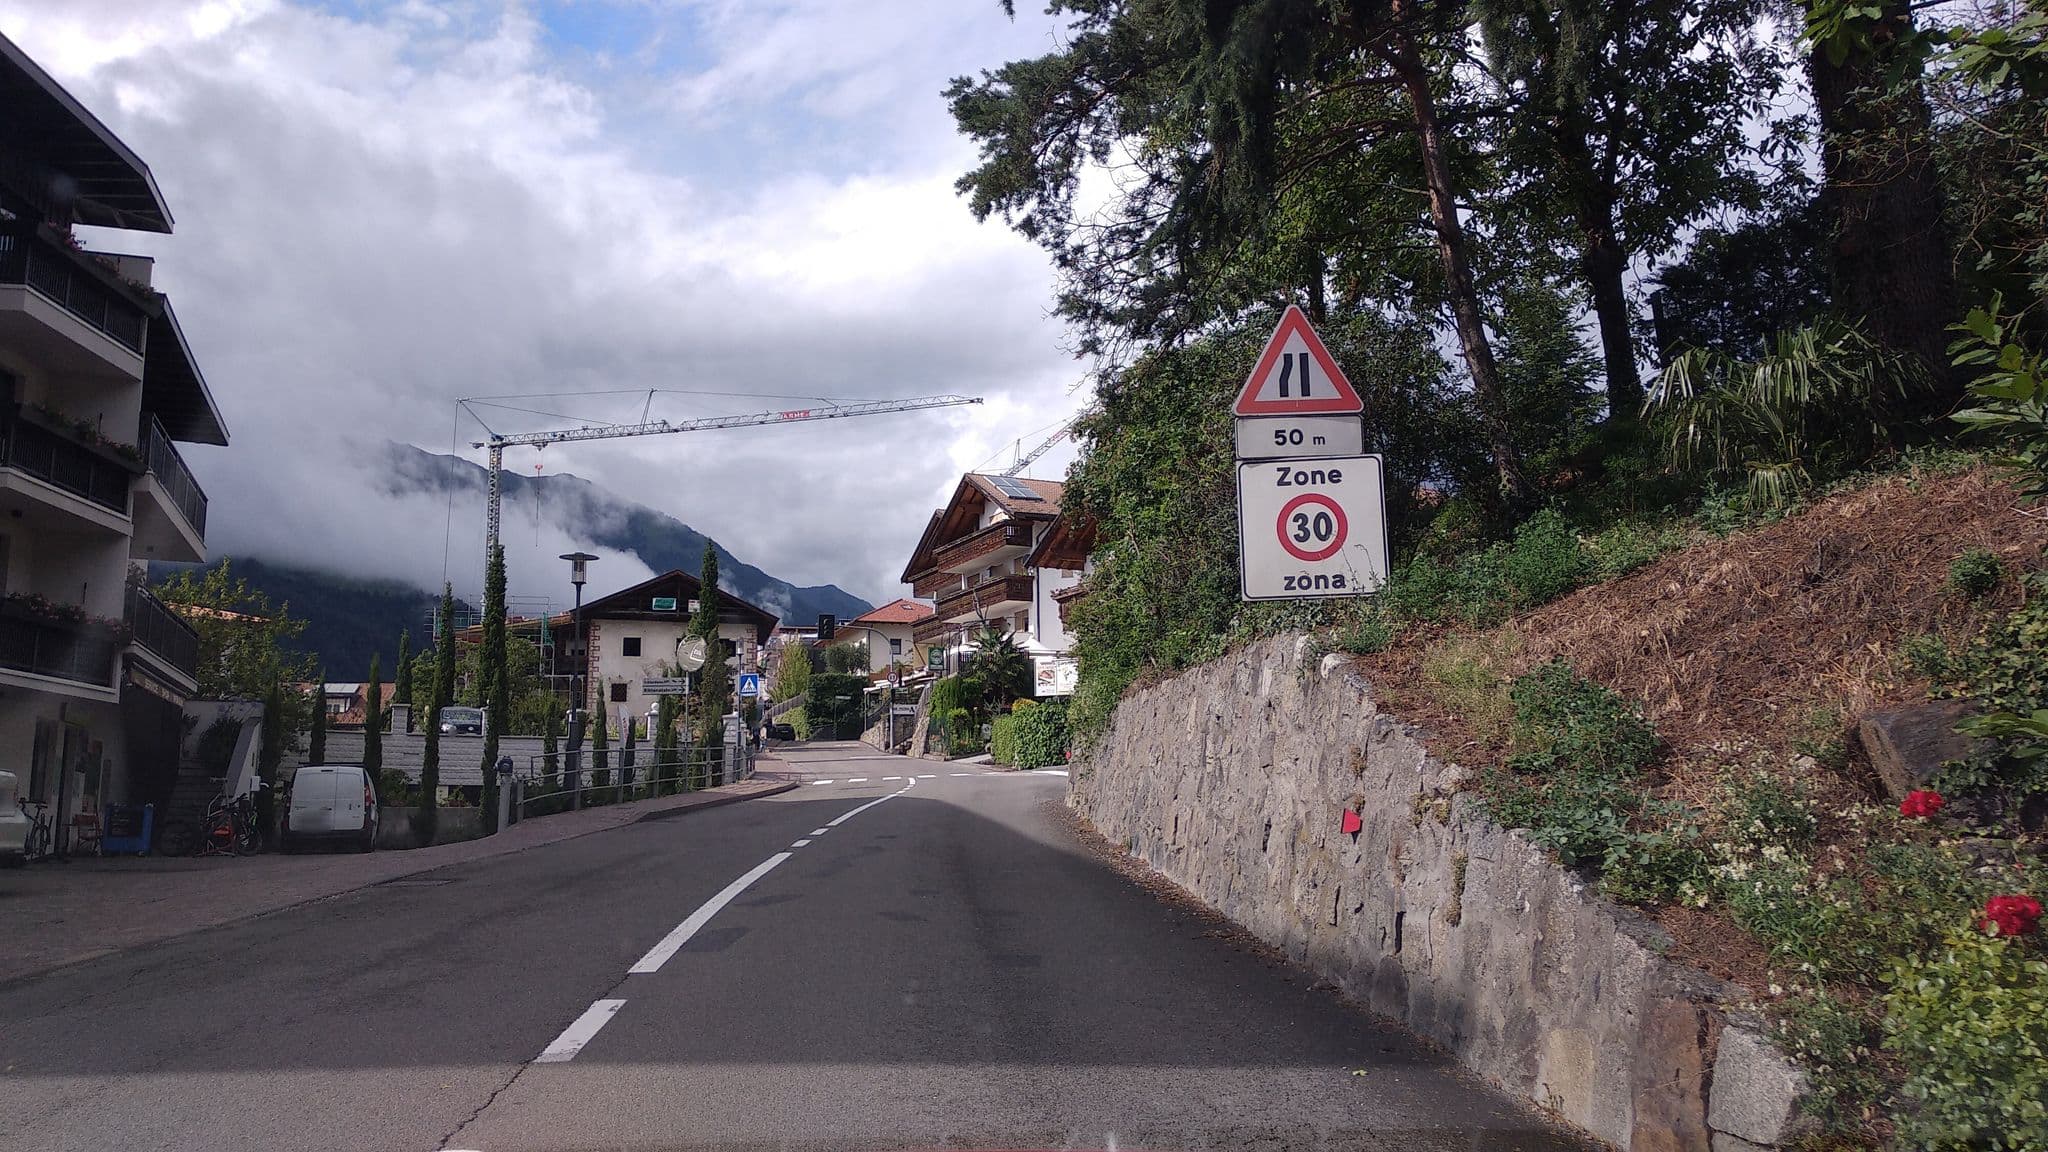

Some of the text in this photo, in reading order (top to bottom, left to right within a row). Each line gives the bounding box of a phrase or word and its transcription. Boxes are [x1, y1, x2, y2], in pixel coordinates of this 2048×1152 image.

[1274, 429, 1326, 446] 50 m
[1276, 467, 1343, 487] Zone
[1292, 511, 1333, 543] 30
[1284, 573, 1346, 591] zona
